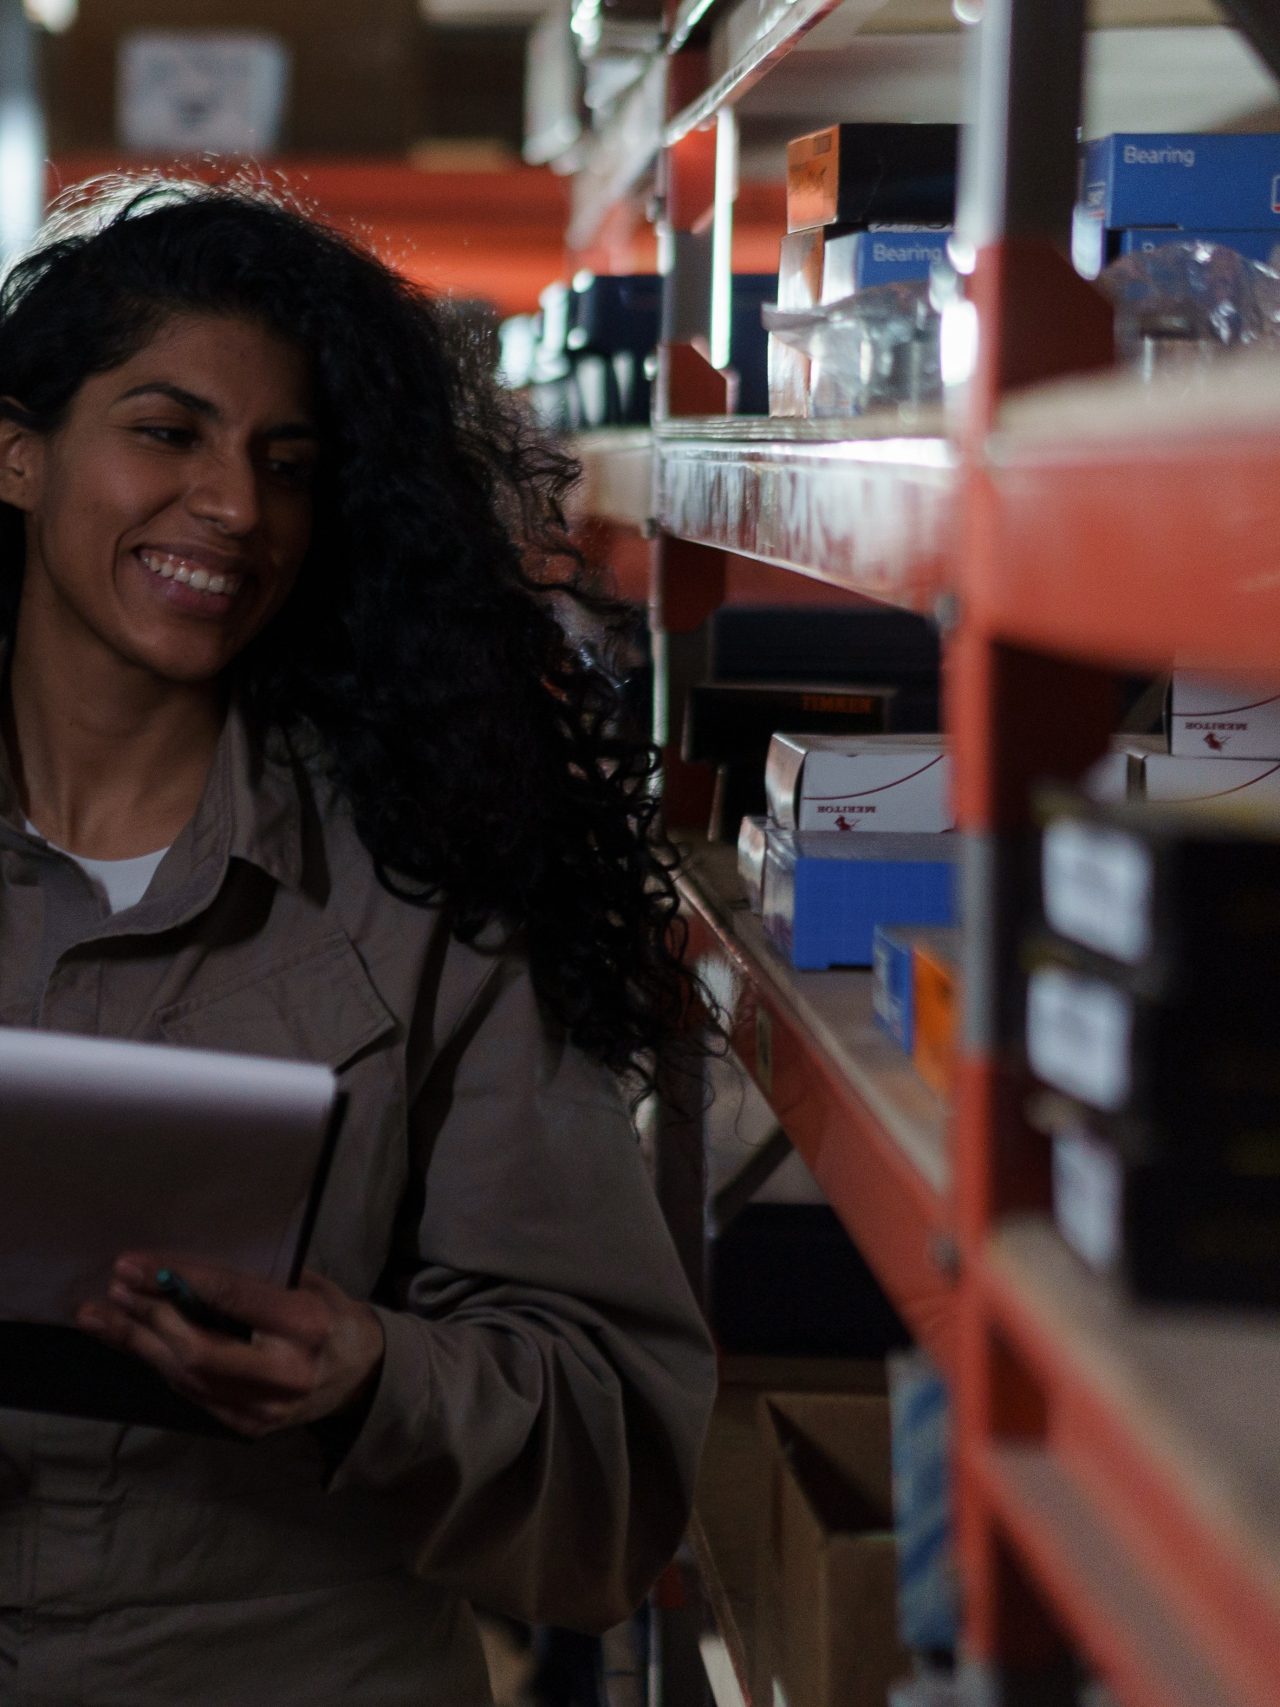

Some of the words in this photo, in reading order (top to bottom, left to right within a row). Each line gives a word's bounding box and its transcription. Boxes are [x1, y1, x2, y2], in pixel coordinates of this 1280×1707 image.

[1123, 144, 1196, 168] Bearing
[873, 240, 943, 265] Bearing
[1184, 722, 1248, 731] MERITOR
[817, 805, 877, 814] MERITOR
